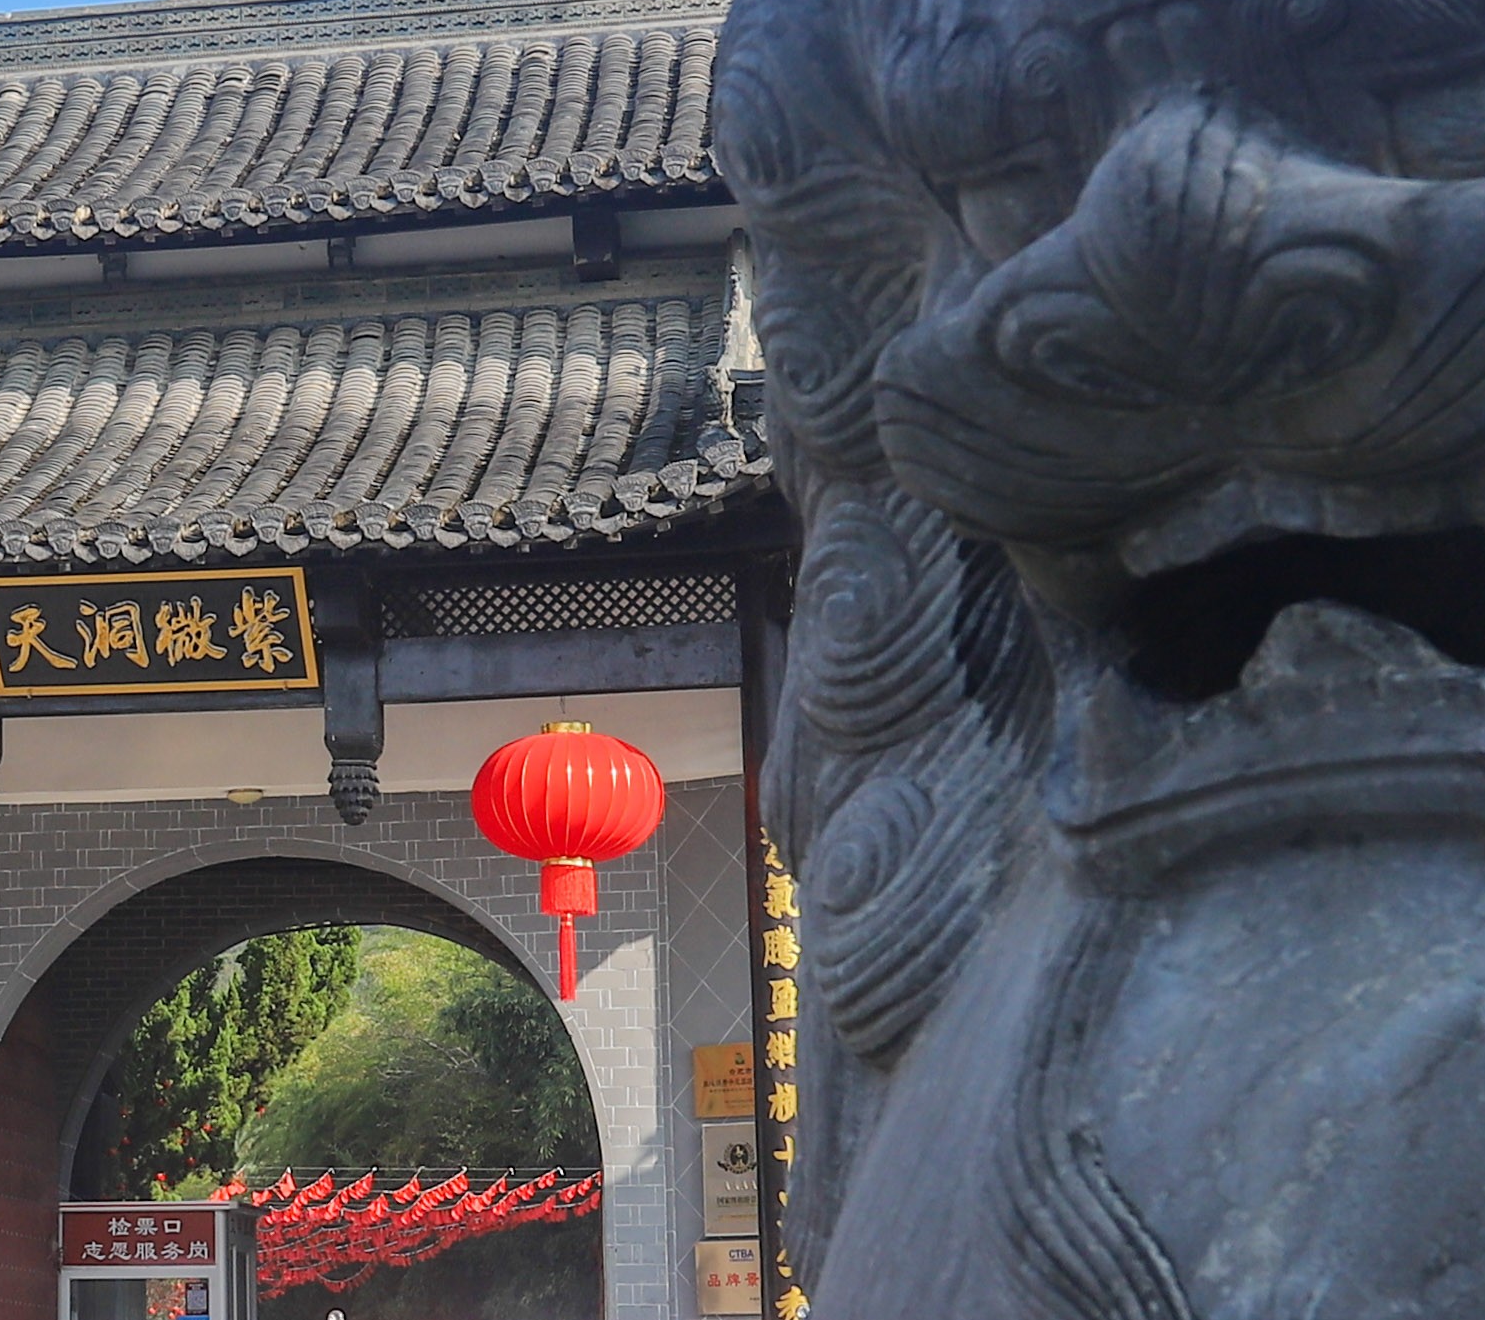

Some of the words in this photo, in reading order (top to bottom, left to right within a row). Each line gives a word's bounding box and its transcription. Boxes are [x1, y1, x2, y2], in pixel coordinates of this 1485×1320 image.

[108, 1217, 181, 1236] 检票口
[81, 1240, 210, 1261] 志愿服务岗
[729, 1249, 754, 1260] CTBA
